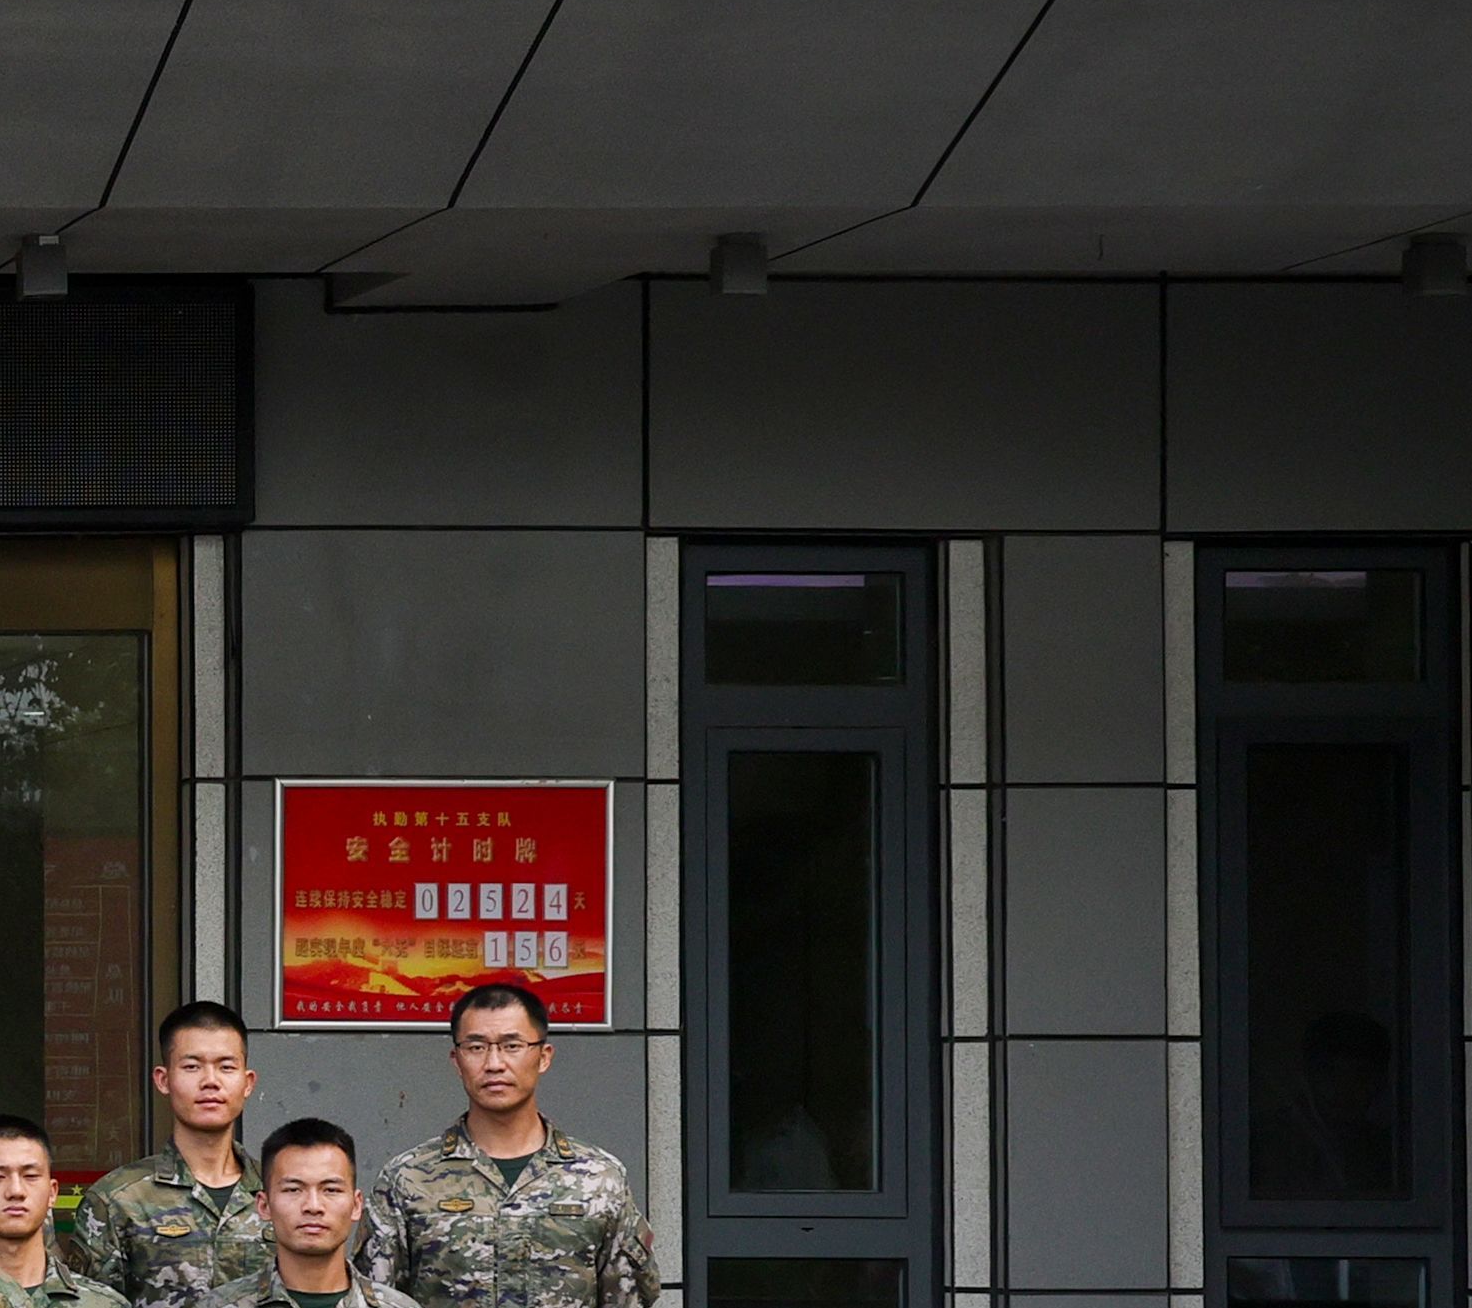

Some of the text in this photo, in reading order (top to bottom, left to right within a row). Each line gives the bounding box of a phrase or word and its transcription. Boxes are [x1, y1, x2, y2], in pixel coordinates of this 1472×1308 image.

[345, 836, 537, 863] 安全计时牌
[488, 936, 563, 962] 156
